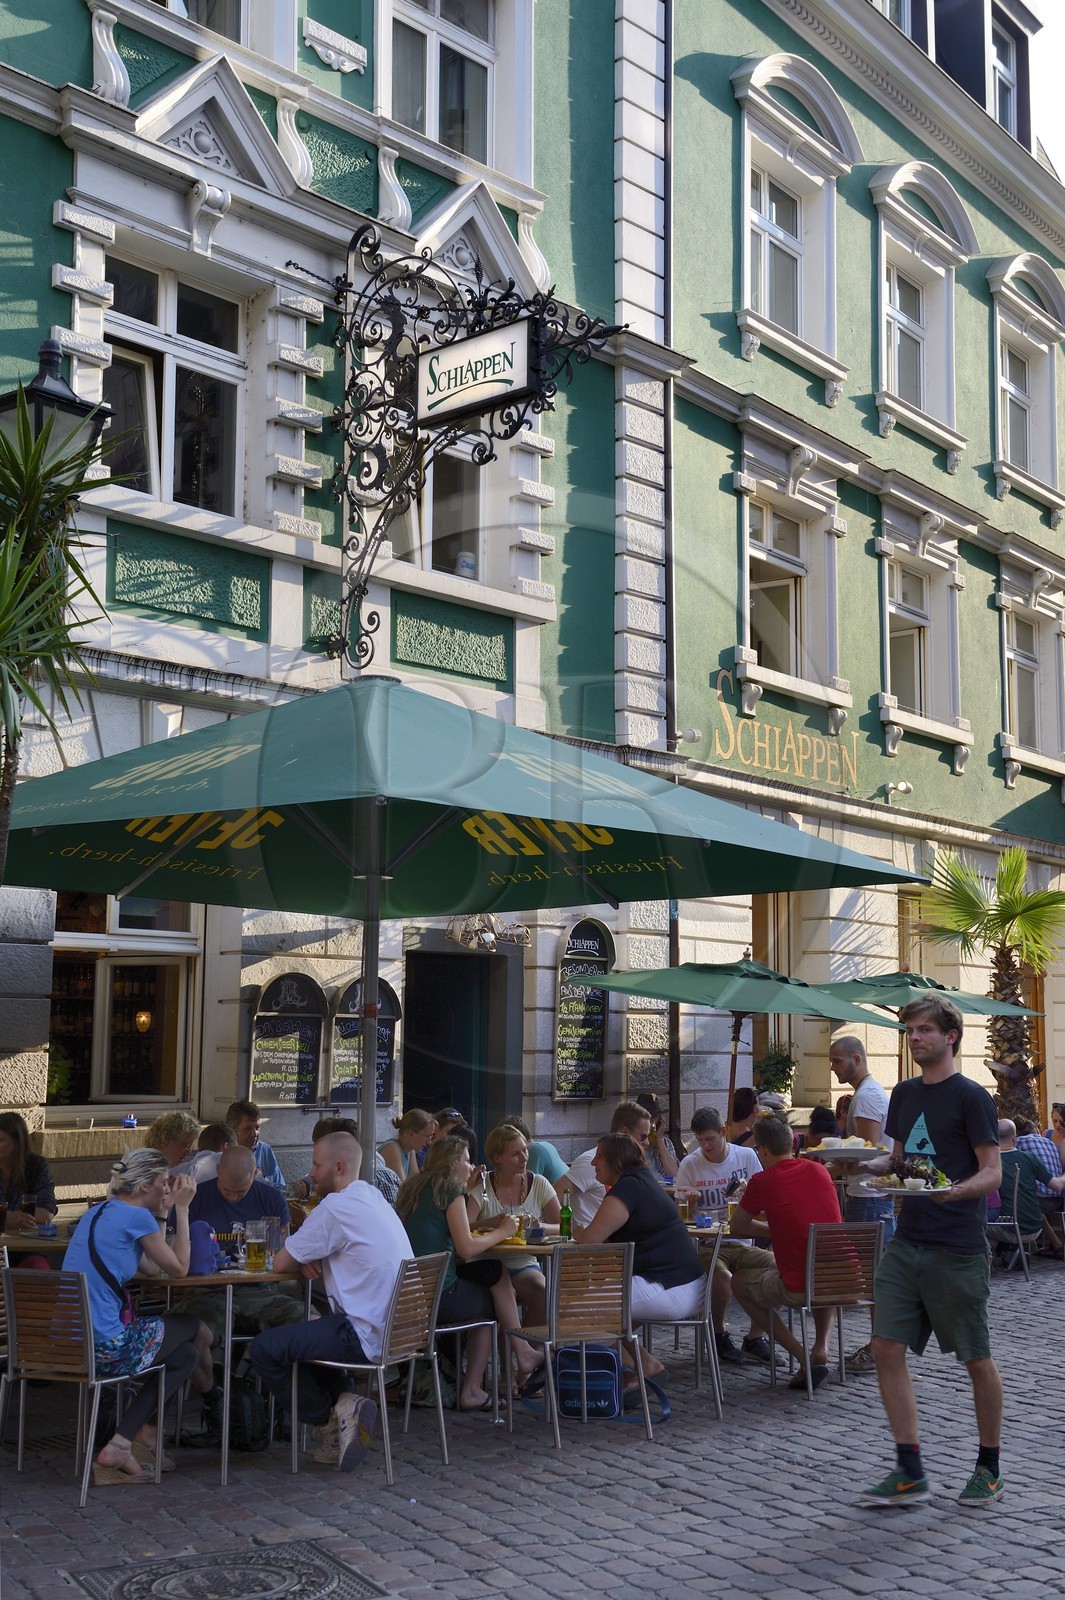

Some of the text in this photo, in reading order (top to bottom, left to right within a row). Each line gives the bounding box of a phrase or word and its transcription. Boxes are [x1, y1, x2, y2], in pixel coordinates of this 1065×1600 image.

[426, 341, 517, 397] SCHLAPPEN
[714, 668, 860, 789] SCHLAPPEN
[566, 936, 600, 950] SCHLAPPEN
[564, 1398, 597, 1409] adias
